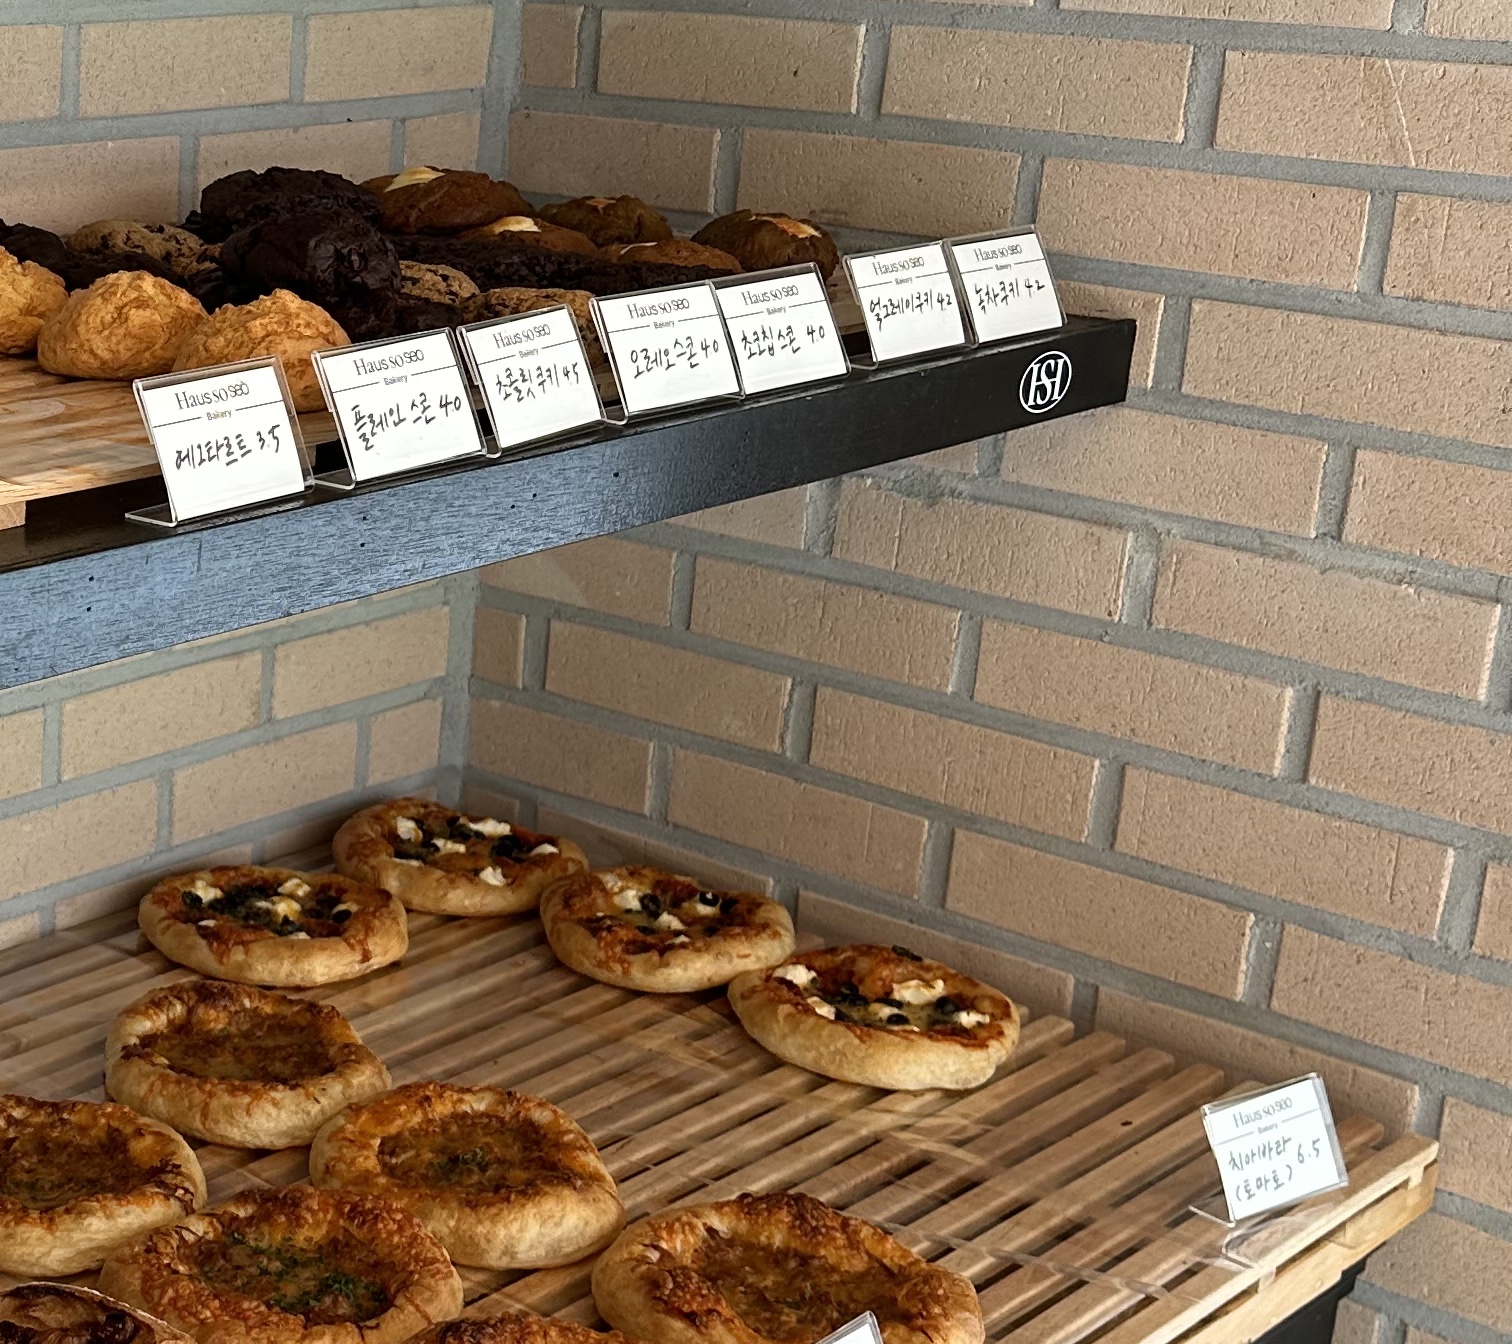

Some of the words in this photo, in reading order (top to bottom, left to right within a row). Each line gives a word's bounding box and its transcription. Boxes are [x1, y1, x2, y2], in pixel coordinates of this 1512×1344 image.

[806, 324, 825, 344] 4.0
[700, 338, 720, 359] 4.0
[439, 393, 462, 418] 4.0
[256, 423, 281, 454] 3.5
[1297, 1137, 1321, 1165] 6.5
